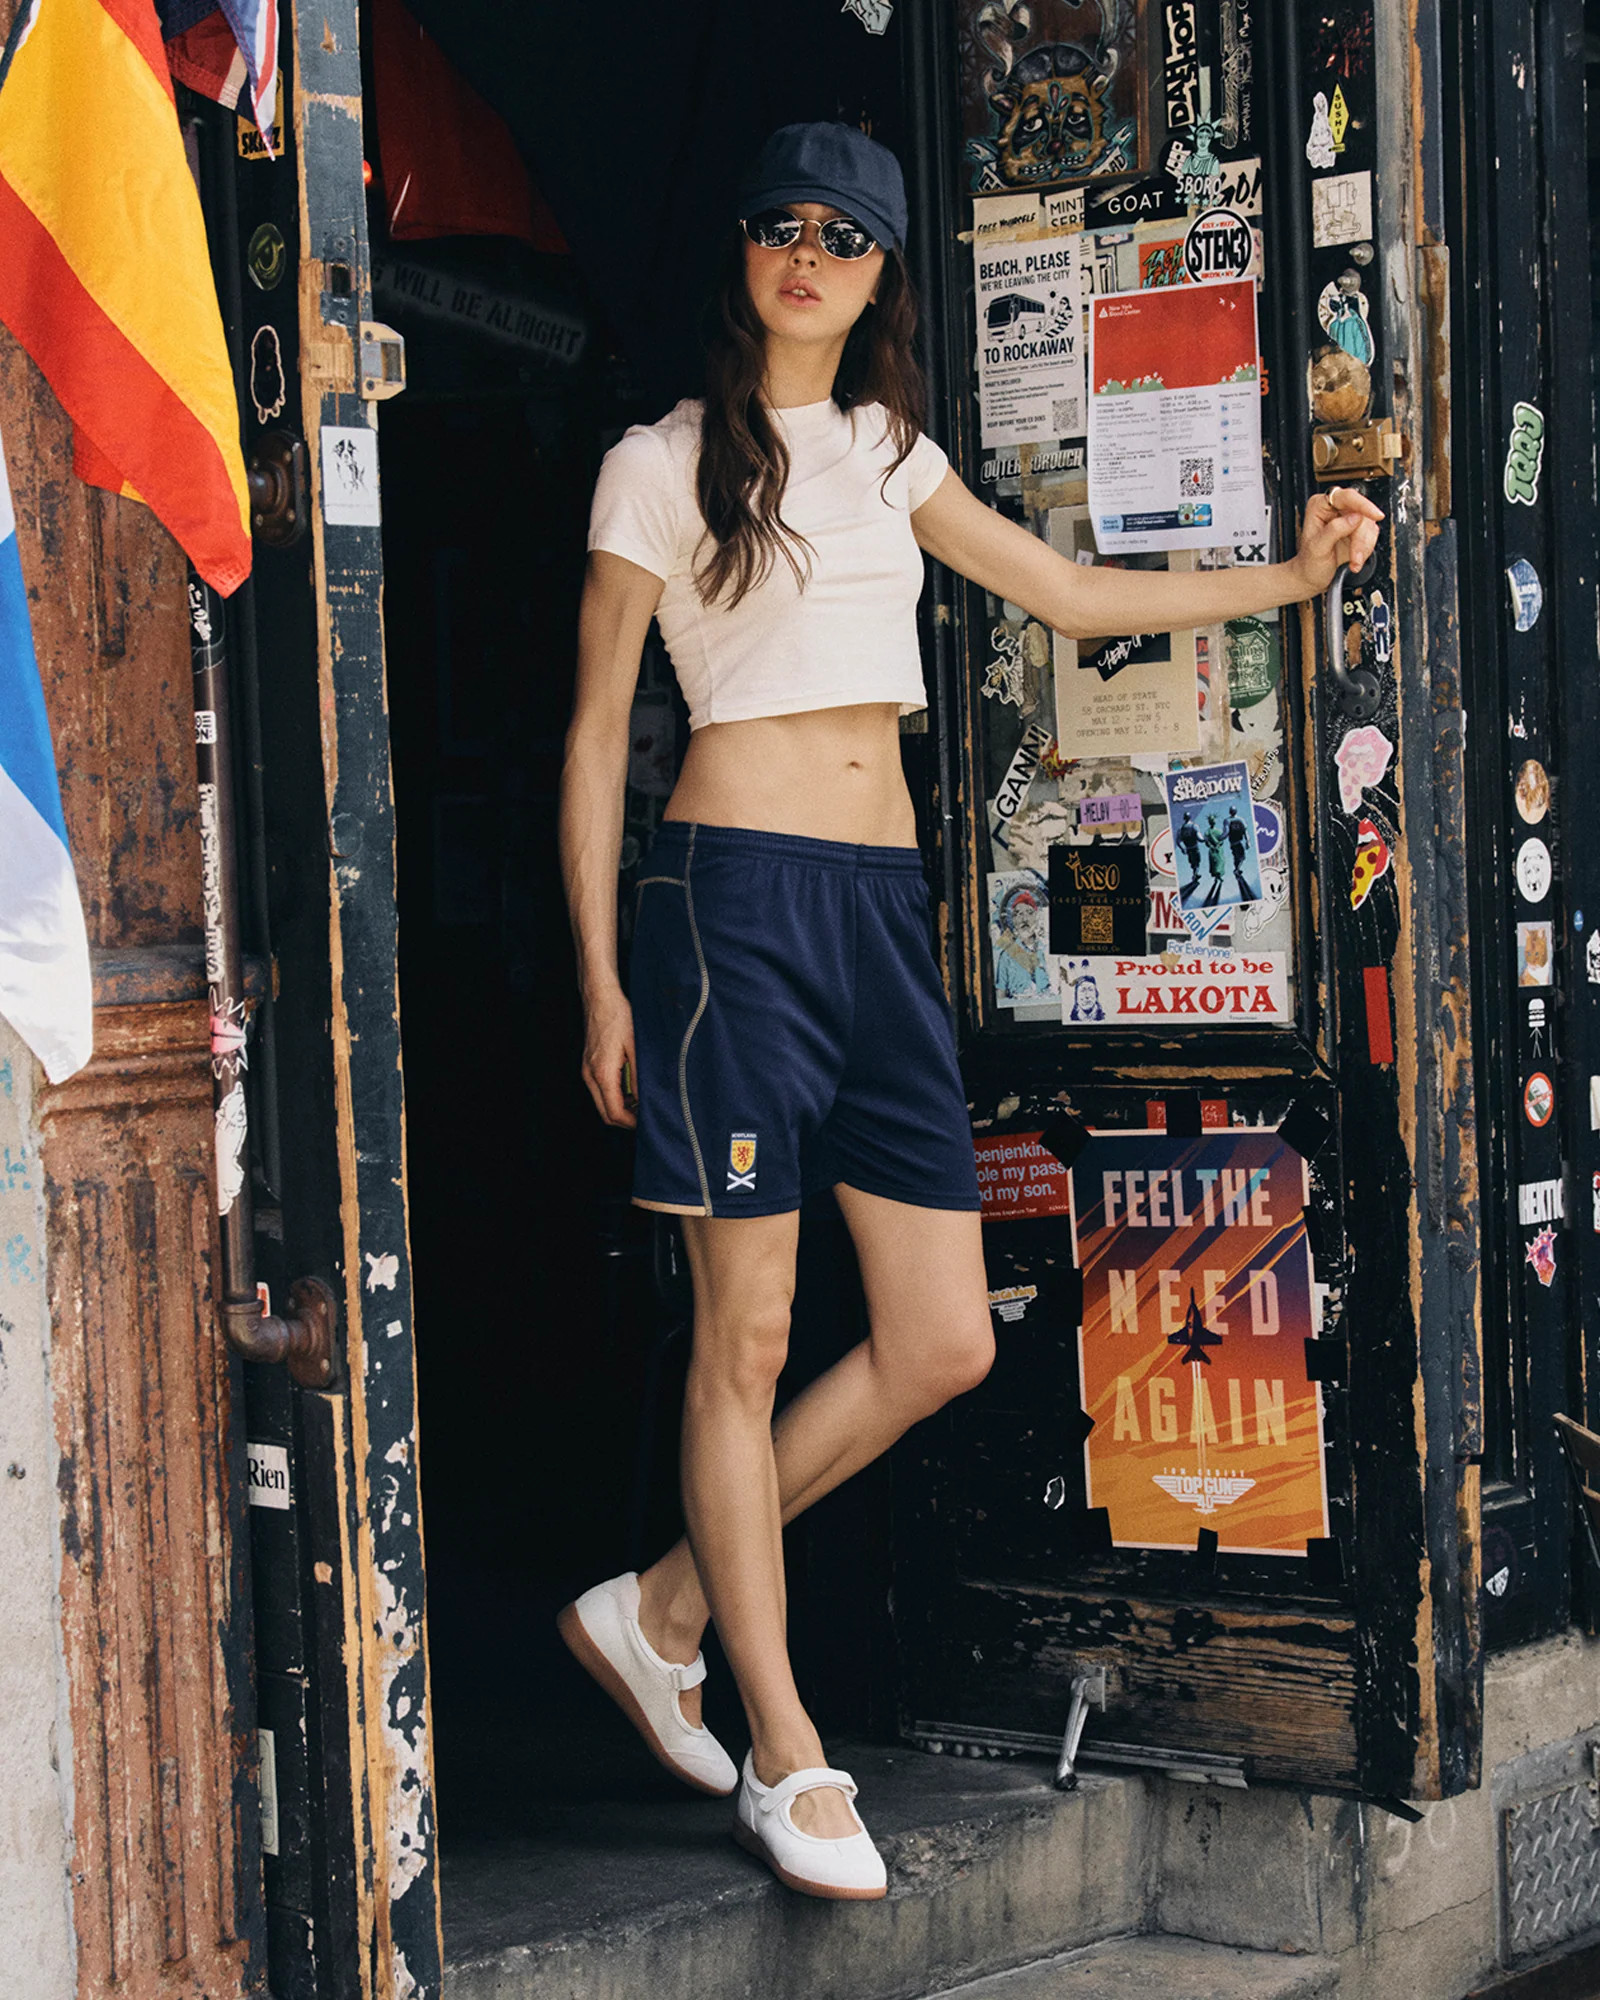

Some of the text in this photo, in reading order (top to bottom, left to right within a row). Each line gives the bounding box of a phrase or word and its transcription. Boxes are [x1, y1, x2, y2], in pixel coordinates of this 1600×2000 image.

[1050, 197, 1085, 215] MINT
[1108, 191, 1164, 214] GOAT
[980, 250, 1071, 280] BEACH, PLEASE
[980, 269, 1070, 292] WE'RE LEAVING THE CITY
[393, 264, 581, 356] WILL BE ALRIGHT
[984, 336, 1074, 364] TO ROCKAWAY
[983, 457, 1021, 479] OUTER
[1030, 447, 1084, 472] OROUGH
[1258, 623, 1271, 637] PUB
[1093, 691, 1157, 702] HEAD OF STATE
[1096, 704, 1131, 714] ORCHARD
[1155, 701, 1171, 710] NYC
[1092, 716, 1107, 724] MAY
[1136, 714, 1151, 722] JUN
[1076, 728, 1110, 737] OPENING
[1114, 726, 1129, 736] MAY
[996, 726, 1050, 818] GANNI
[1177, 775, 1194, 788] the
[1172, 776, 1243, 802] SHADOW
[1171, 896, 1205, 941] ERON
[1167, 942, 1231, 958] For Everyone
[1115, 958, 1274, 976] Proud to be
[1116, 985, 1278, 1014] LAKOTA
[1002, 1165, 1025, 1182] my
[997, 1186, 1019, 1202] my
[1024, 1183, 1056, 1198] son.
[1102, 1168, 1273, 1228] FEEL THE
[1108, 1269, 1280, 1336] NEED
[1112, 1376, 1287, 1447] AGAIN
[248, 1458, 286, 1490] Rien
[1176, 1477, 1233, 1495] TOP GUN
